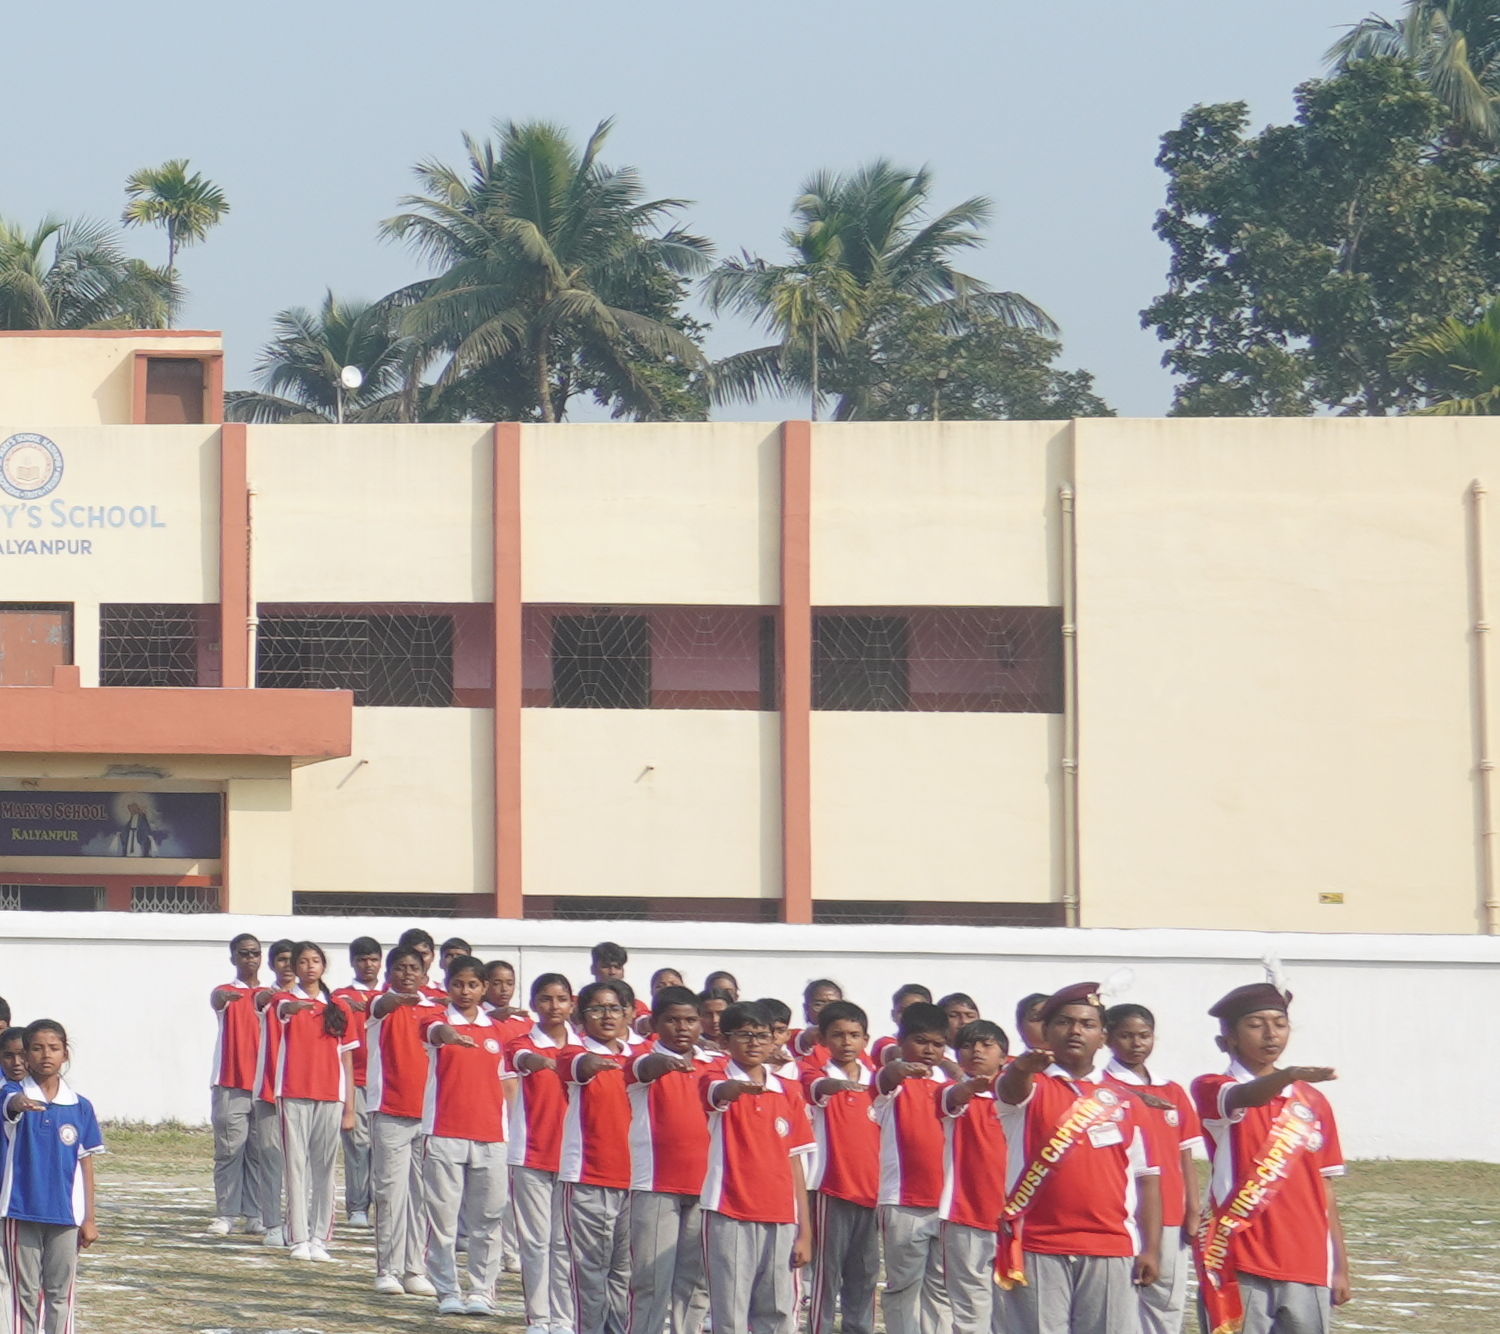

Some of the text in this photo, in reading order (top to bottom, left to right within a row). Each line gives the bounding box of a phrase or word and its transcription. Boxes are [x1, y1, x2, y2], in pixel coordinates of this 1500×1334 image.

[49, 498, 167, 528] SCHOOL
[1, 801, 51, 820] MARY'S
[54, 802, 107, 821] SCHOOL
[11, 827, 80, 841] KALYANPUR
[1004, 1098, 1104, 1215] HOUSE CAPTAIN
[1204, 1117, 1309, 1270] HOUSE VICE-CAPTAIN
